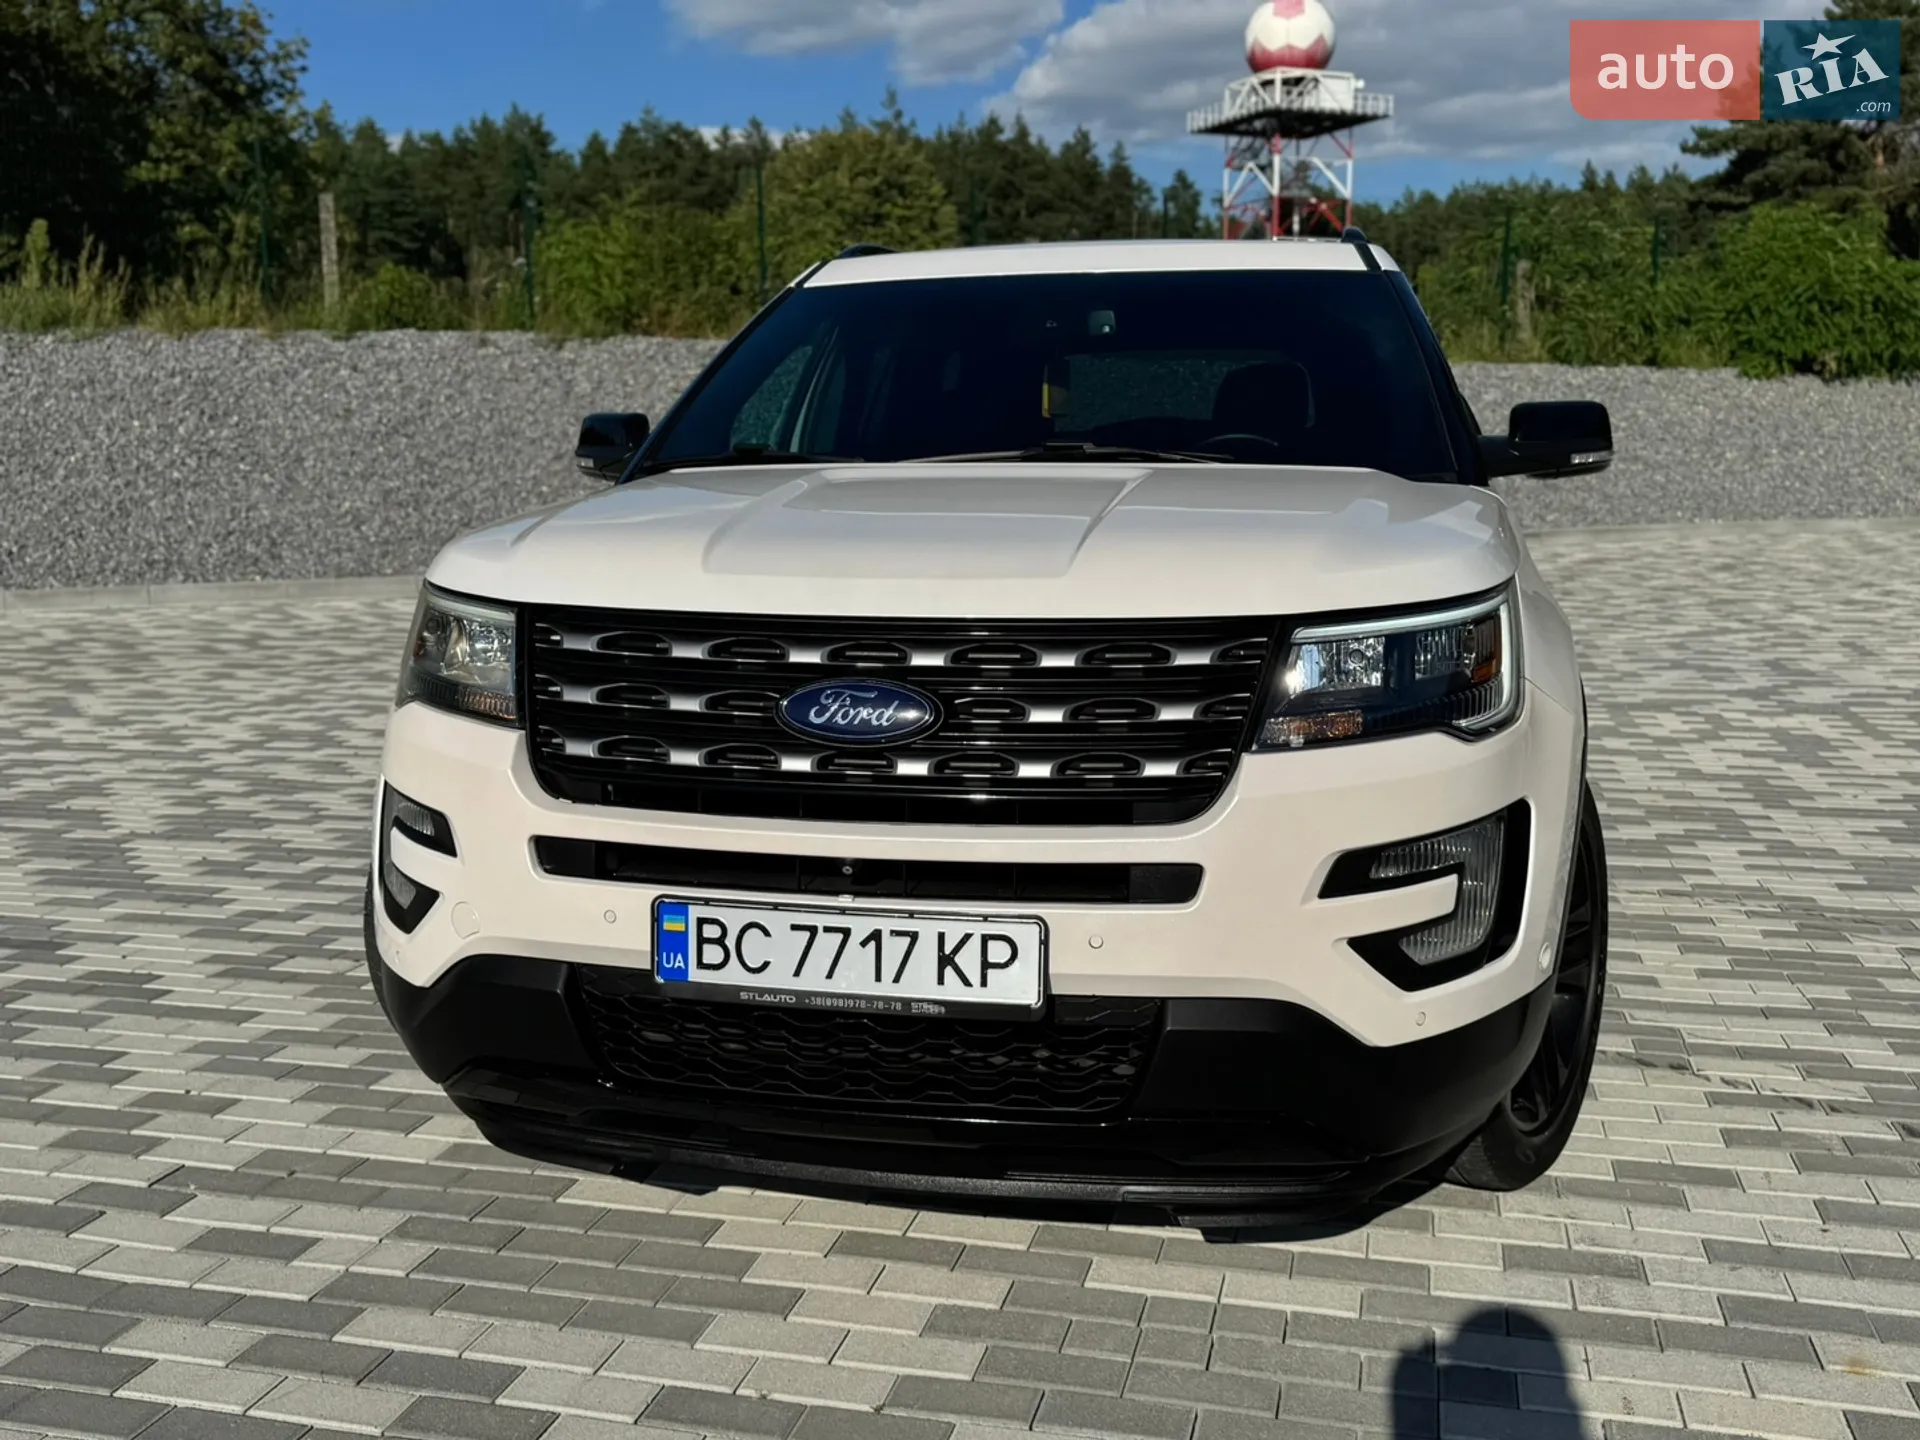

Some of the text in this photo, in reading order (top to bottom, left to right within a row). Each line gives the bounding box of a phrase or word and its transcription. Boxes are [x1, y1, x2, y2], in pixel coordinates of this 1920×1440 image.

[808, 688, 900, 727] Ford
[662, 951, 686, 970] UA
[695, 916, 1019, 988] BC 7717 KP
